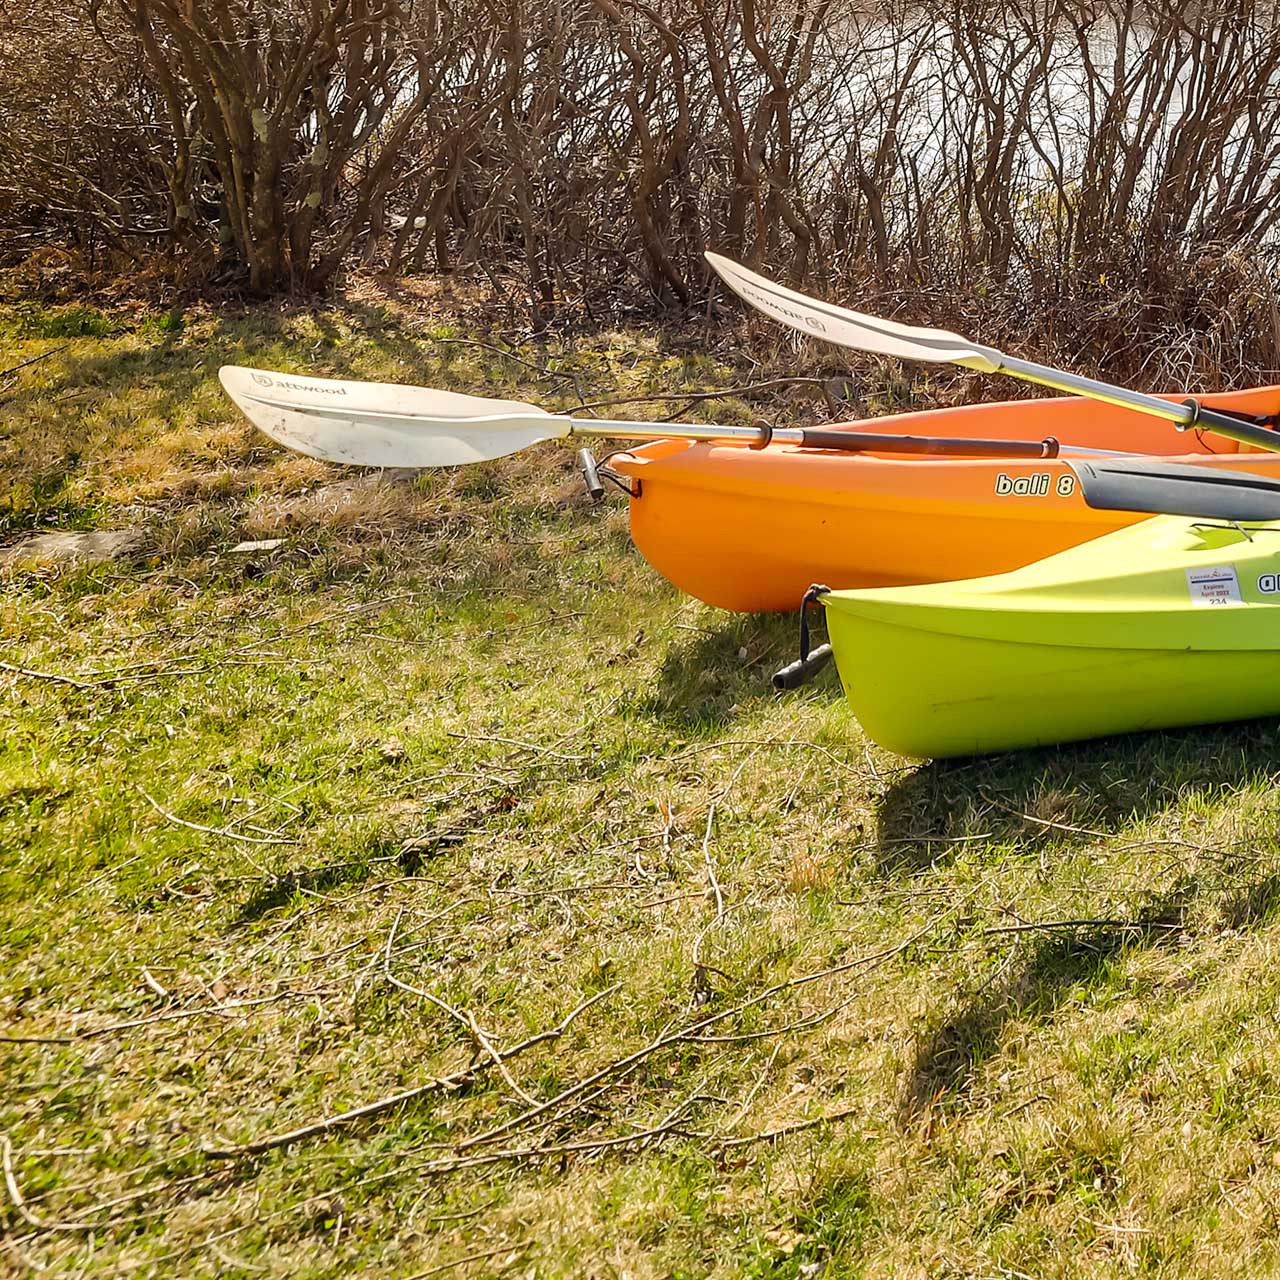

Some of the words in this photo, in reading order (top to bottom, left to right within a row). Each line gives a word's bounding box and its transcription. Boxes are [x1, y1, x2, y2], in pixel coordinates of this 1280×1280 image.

[742, 287, 804, 321] attwood
[275, 380, 348, 395] attwood
[995, 473, 1051, 496] bali
[1056, 474, 1075, 496] 8
